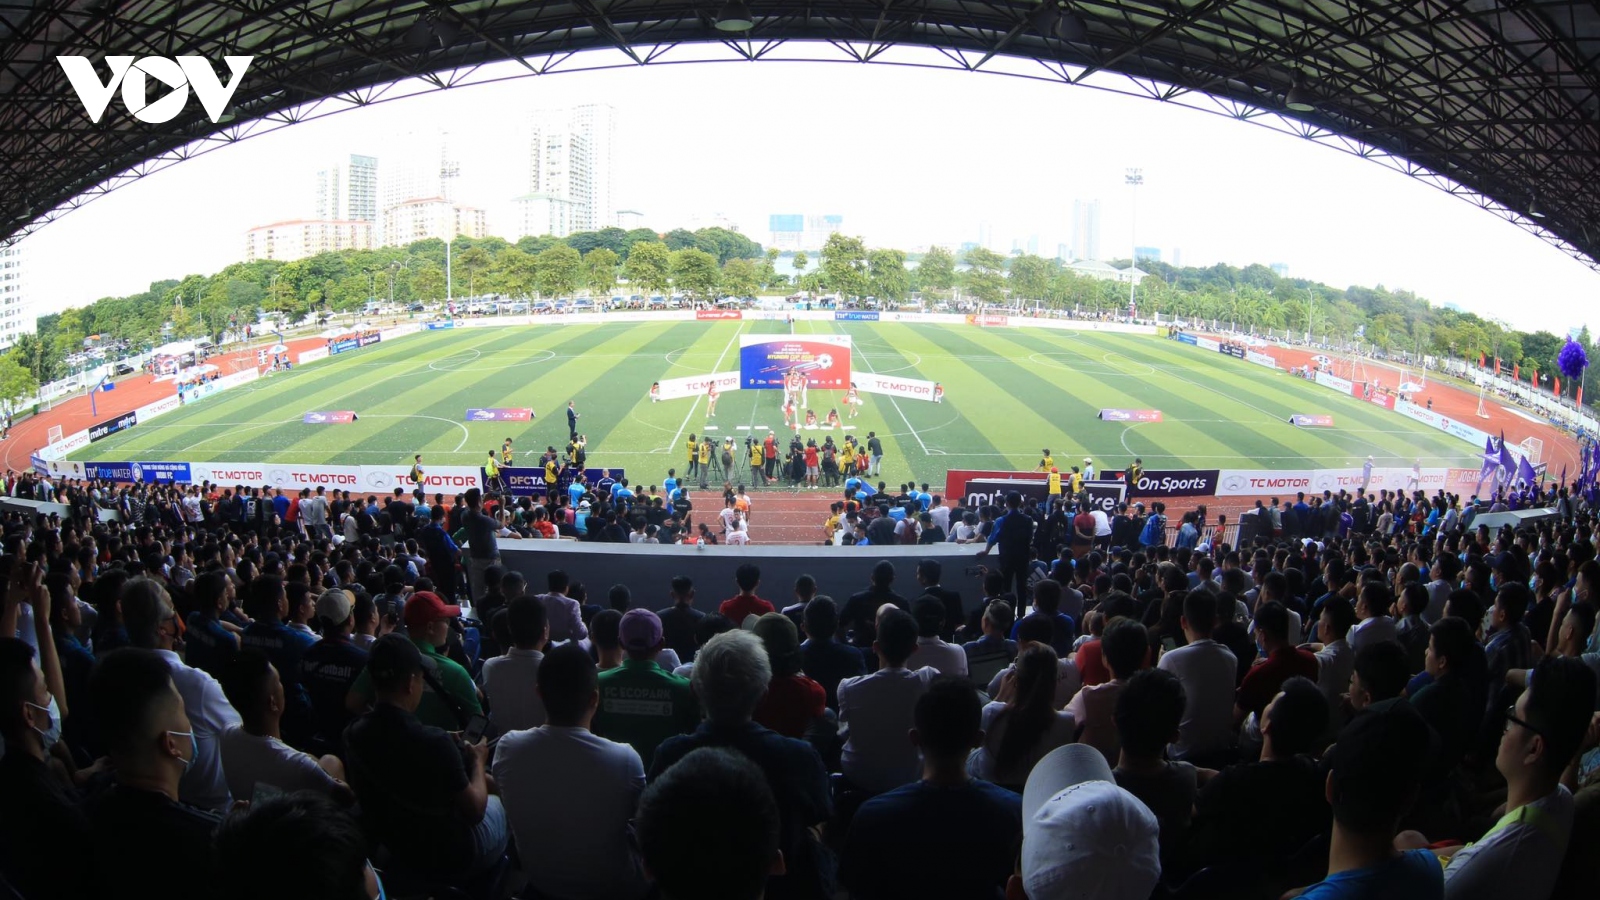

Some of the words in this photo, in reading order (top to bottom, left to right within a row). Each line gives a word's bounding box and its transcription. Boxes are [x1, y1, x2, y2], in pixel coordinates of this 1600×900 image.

[686, 382, 699, 390] TC
[875, 380, 888, 389] TC
[890, 383, 930, 394] MOTOR
[157, 398, 178, 411] MOTOR
[1406, 406, 1414, 414] TC
[1413, 408, 1434, 422] MOTOR
[55, 445, 64, 454] TC
[64, 434, 89, 450] MOTOR
[211, 470, 224, 479] TC
[225, 471, 263, 480] MOTOR
[291, 473, 307, 483] TC
[309, 474, 357, 484] MOTOR
[509, 475, 548, 485] DFCTA
[1337, 476, 1349, 485] TC
[1350, 475, 1383, 485] MOOR
[1137, 477, 1158, 490] On
[1159, 476, 1206, 492] Sports
[1250, 478, 1264, 488] TC
[1266, 478, 1309, 488] MOTOR
[604, 686, 618, 698] FC
[620, 687, 672, 699] ECOPARK
